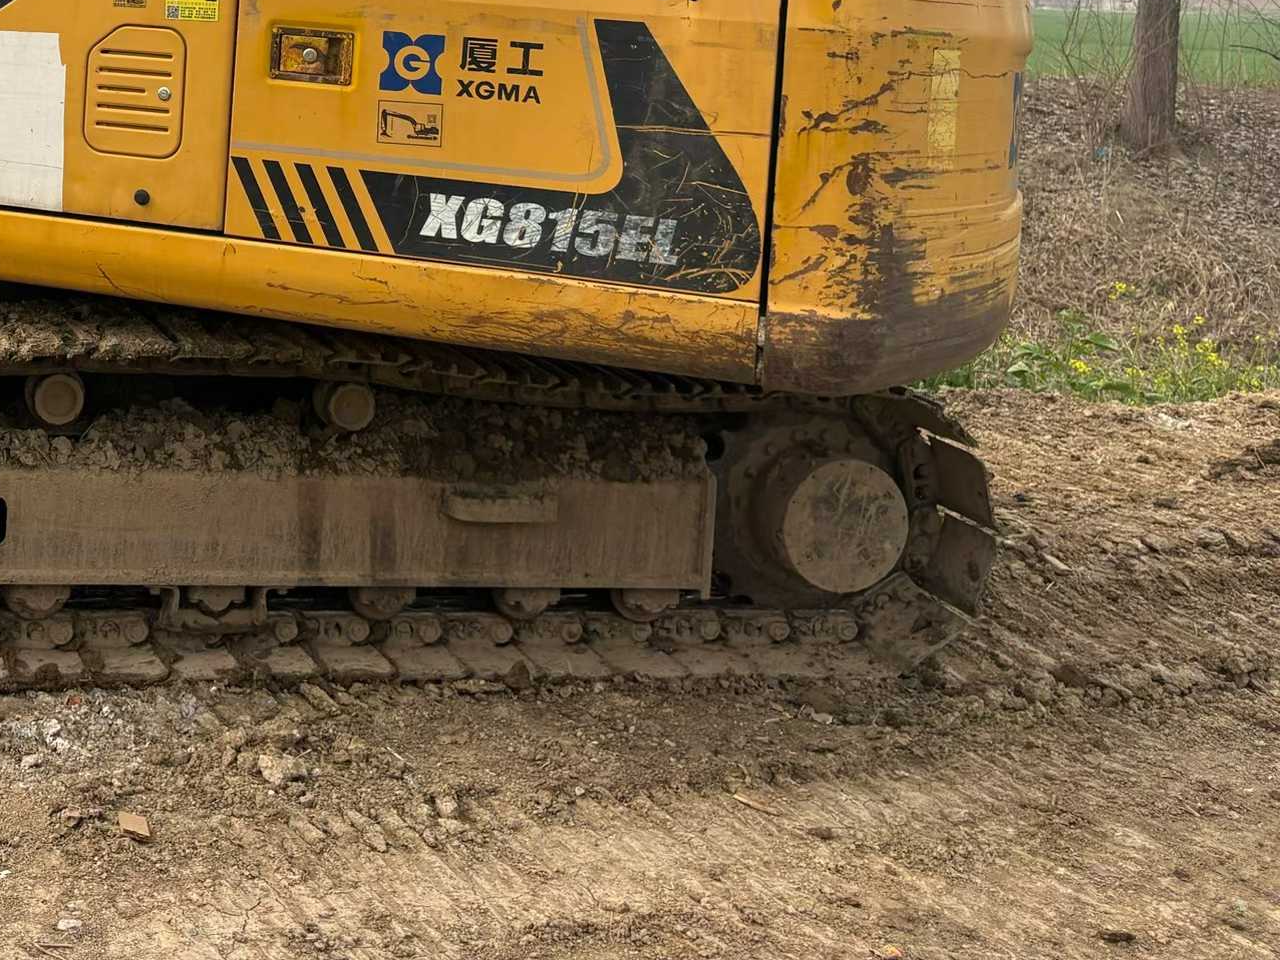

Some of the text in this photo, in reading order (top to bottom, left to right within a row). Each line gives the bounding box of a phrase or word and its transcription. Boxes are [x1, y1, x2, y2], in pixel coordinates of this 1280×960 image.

[459, 36, 544, 77] 厦工
[456, 79, 541, 105] XGMA
[419, 192, 679, 266] XG815EL
